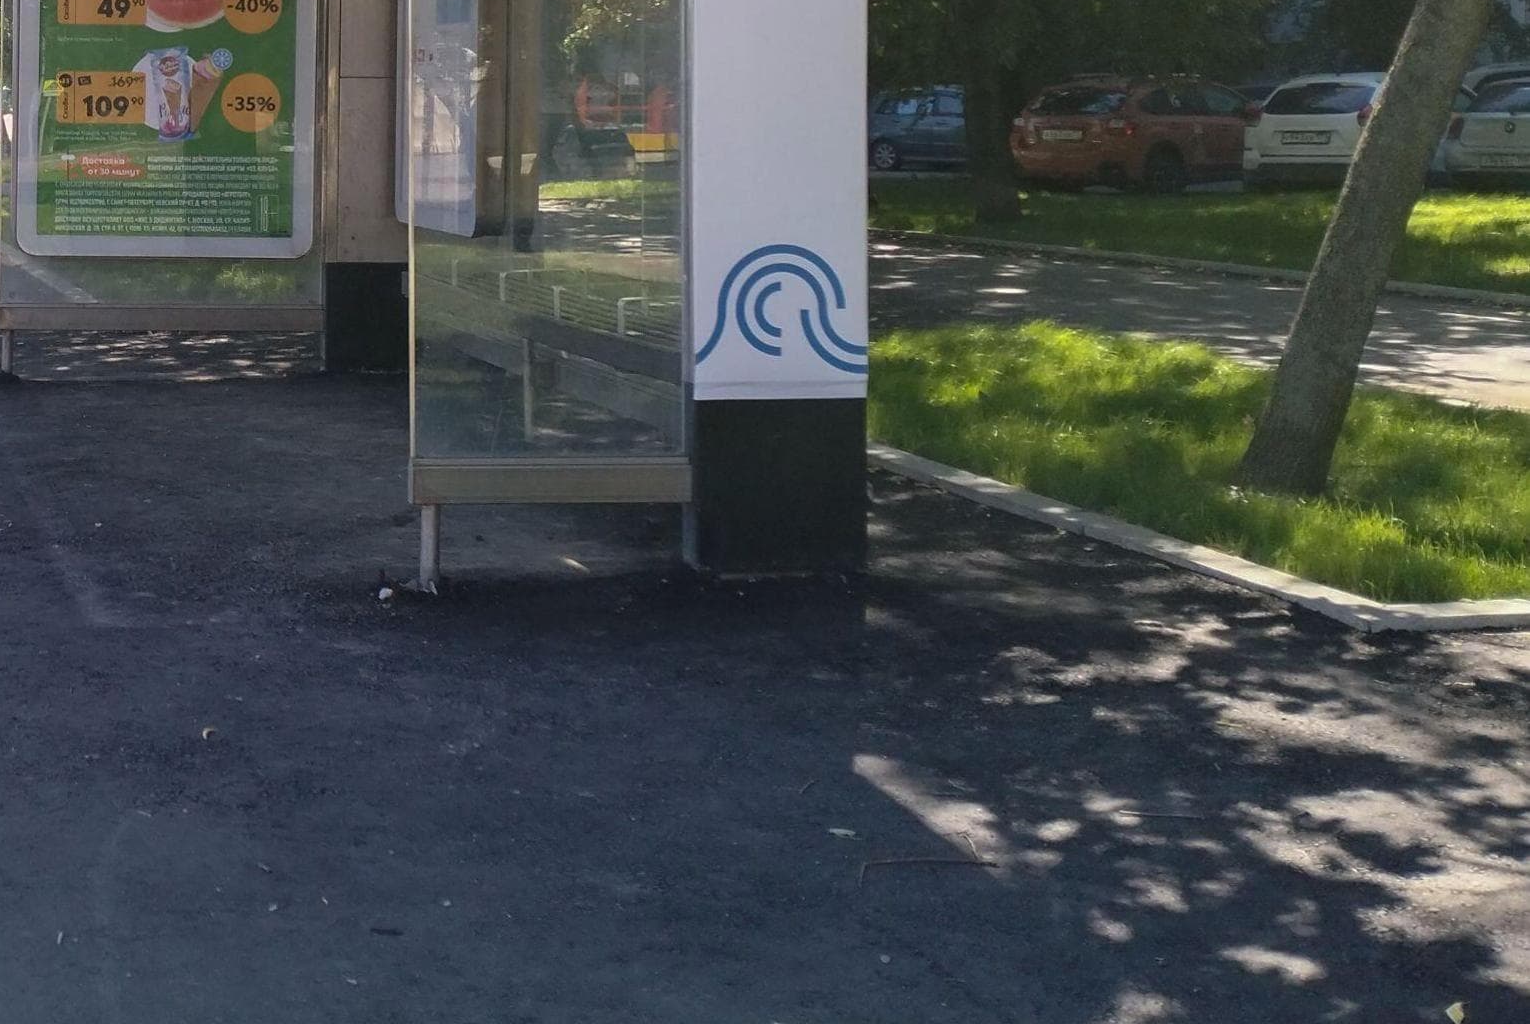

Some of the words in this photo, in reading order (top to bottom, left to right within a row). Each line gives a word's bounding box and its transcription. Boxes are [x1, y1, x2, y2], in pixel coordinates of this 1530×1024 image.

[82, 95, 130, 118] 109
[131, 96, 145, 106] 90
[226, 96, 276, 112] -35%
